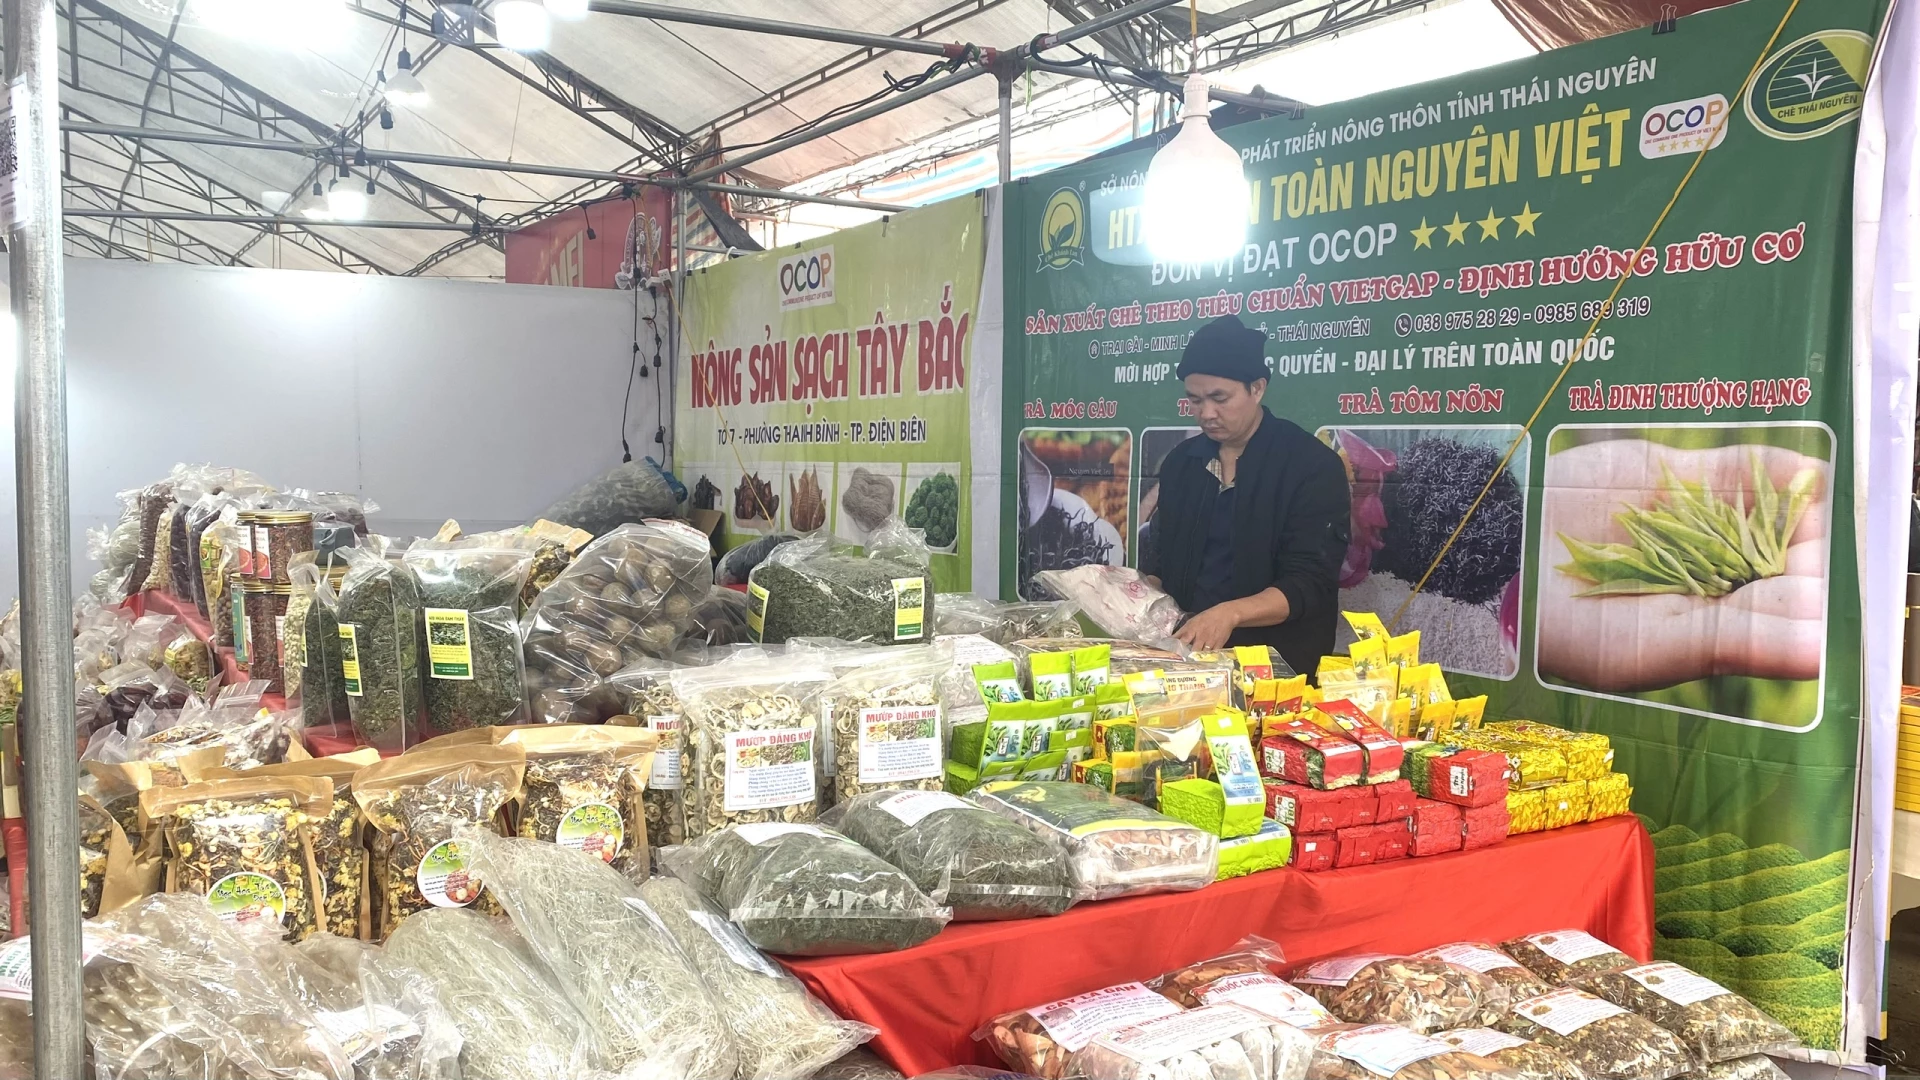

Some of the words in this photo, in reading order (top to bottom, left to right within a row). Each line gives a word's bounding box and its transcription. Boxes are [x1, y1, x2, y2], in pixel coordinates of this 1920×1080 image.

[1241, 137, 1281, 164] PHÁT
[1284, 122, 1326, 156] TRIỂN
[1331, 113, 1384, 149] NÔNG
[1389, 103, 1442, 138] THÔN
[1446, 91, 1496, 122] TỈNH
[1500, 74, 1550, 110] THÁI
[1558, 55, 1657, 100] NGUYÊN
[1645, 100, 1724, 136] OCOP
[1778, 105, 1795, 119] CHÈ
[1798, 104, 1817, 115] THÁI
[1819, 93, 1858, 111] NGUYÊN
[1271, 158, 1354, 222] TOÀN
[1364, 120, 1518, 207] NGUYÊN
[1534, 102, 1632, 185] VIỆT
[1101, 174, 1118, 197] SỞ
[1120, 169, 1148, 192] NÔN
[1214, 255, 1234, 284] VỊ
[1244, 237, 1300, 279] ĐẠT
[1308, 222, 1398, 266] OCOP
[780, 252, 831, 296] OCOP
[1025, 307, 1060, 337] SẢN
[1062, 302, 1106, 331] XUẤT
[1108, 300, 1143, 329] CHÈ
[1145, 300, 1194, 326] THEO
[1197, 289, 1243, 319] TIÊU
[1246, 272, 1325, 313] CHUẨN
[1330, 271, 1440, 307] VIETGAP
[1443, 279, 1454, 291] -
[1459, 259, 1534, 298] ĐỊNH
[1539, 244, 1657, 288] HƯỚNG
[1664, 232, 1745, 274] HỮU
[1752, 221, 1807, 265] CƠ
[1277, 322, 1309, 343] THÁI
[1311, 318, 1371, 340] NGUYÊN
[1414, 315, 1442, 333] 038
[1445, 312, 1474, 331] 975
[1476, 310, 1496, 328] 28
[1499, 307, 1520, 326] 29
[1535, 302, 1576, 323] 0985
[1580, 299, 1614, 320] 689
[1616, 297, 1651, 317] 319
[691, 340, 742, 408] NÔNG
[749, 325, 787, 405] SẢN
[792, 332, 849, 415] SẠCH
[857, 311, 909, 396] TÂY
[918, 285, 969, 392] BẮC
[1102, 338, 1124, 359] TRẠI
[1125, 333, 1143, 355] CÀI
[1152, 335, 1179, 353] MINH
[1278, 347, 1337, 377] QUYỀN
[1354, 350, 1386, 377] ĐẠI
[1392, 345, 1415, 371] LÝ
[1422, 341, 1477, 370] TRÊN
[1484, 335, 1544, 367] TOÀN
[1550, 328, 1616, 365] QUỐC
[1114, 362, 1140, 384] MỜI
[1142, 364, 1171, 388] HỢP
[1049, 397, 1086, 420] MÓC
[1087, 396, 1119, 419] CÂU
[1337, 390, 1385, 416] TRÀ
[1389, 385, 1440, 415] TÔM
[1446, 384, 1504, 414] NÕN
[1568, 378, 1607, 413] TRÀ
[1609, 384, 1657, 411] ĐINH
[1660, 378, 1748, 416] THƯỢNG
[1750, 377, 1812, 415] HẠNG
[729, 427, 736, 445] 7
[783, 424, 813, 443] THANH
[815, 419, 840, 443] BÌNH
[850, 422, 866, 443] TP.
[868, 415, 895, 447] ĐIỆN
[900, 415, 927, 442] BIÊN
[866, 711, 893, 723] MƯỚP
[921, 707, 936, 719] KHÔ
[736, 734, 766, 747] MƯỚP
[769, 731, 797, 744] ĐẮNG
